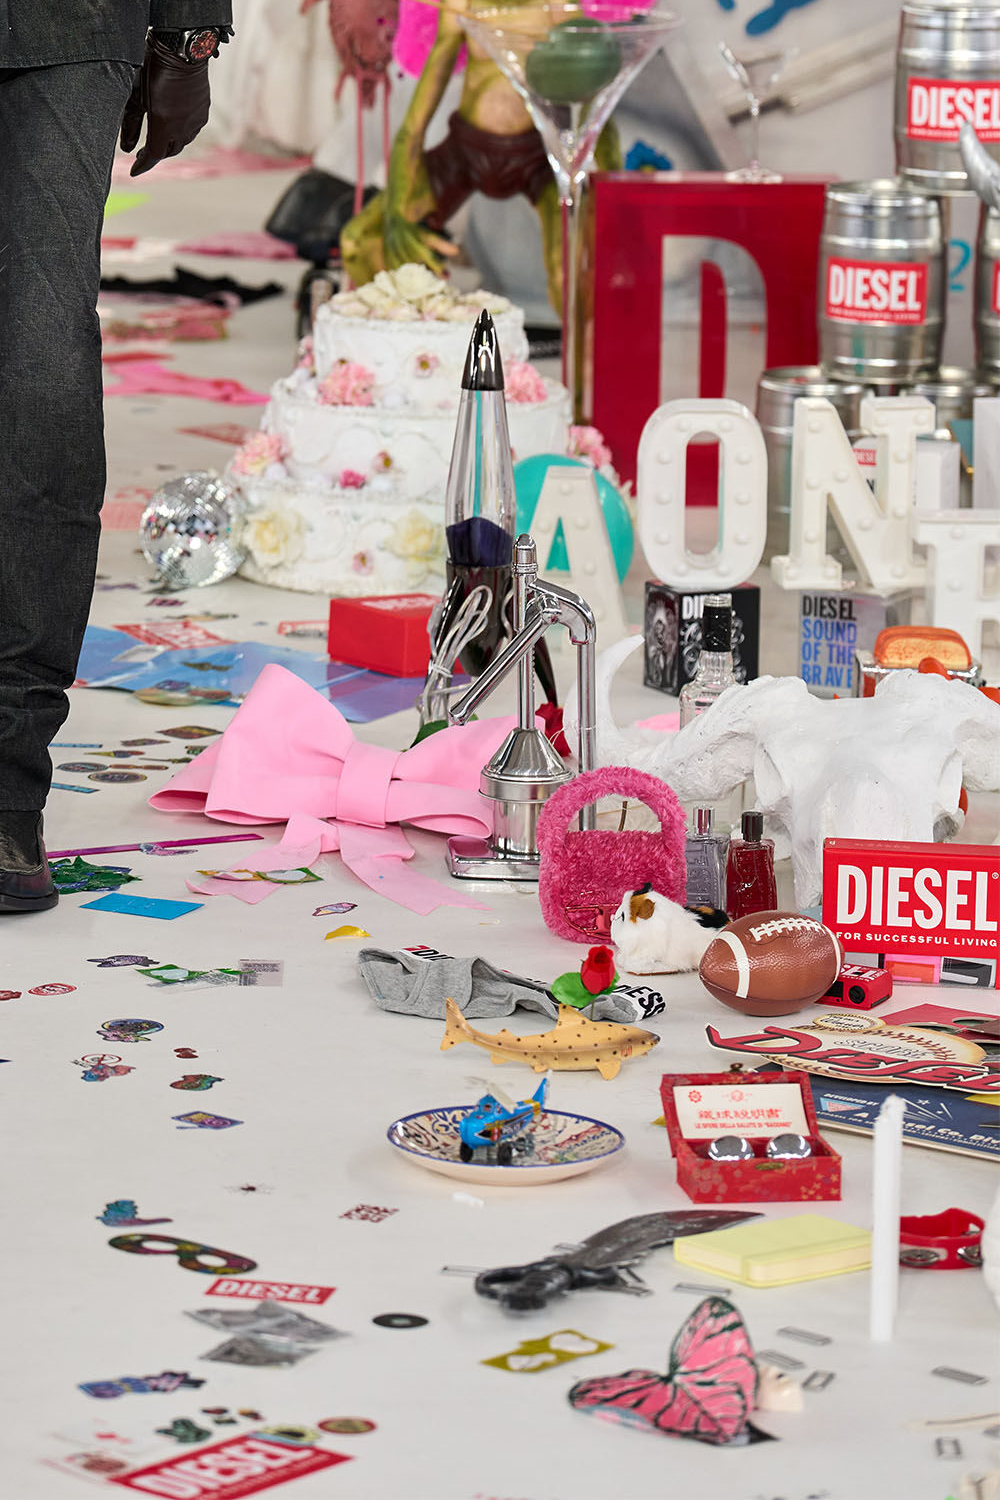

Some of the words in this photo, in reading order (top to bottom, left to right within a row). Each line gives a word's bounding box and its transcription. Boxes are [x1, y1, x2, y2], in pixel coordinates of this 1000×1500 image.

[829, 265, 921, 311] DIESEL
[802, 595, 857, 621] DIESEL
[802, 618, 857, 644] SOUND
[802, 641, 821, 662] OF
[826, 643, 856, 666] THE
[837, 864, 998, 932] DIESEL
[836, 932, 861, 941] FOR
[866, 933, 949, 945] SUCCESSFUL
[954, 938, 997, 947] LIVING
[215, 1280, 321, 1302] DIESEL
[130, 1438, 317, 1500] DIESEL
